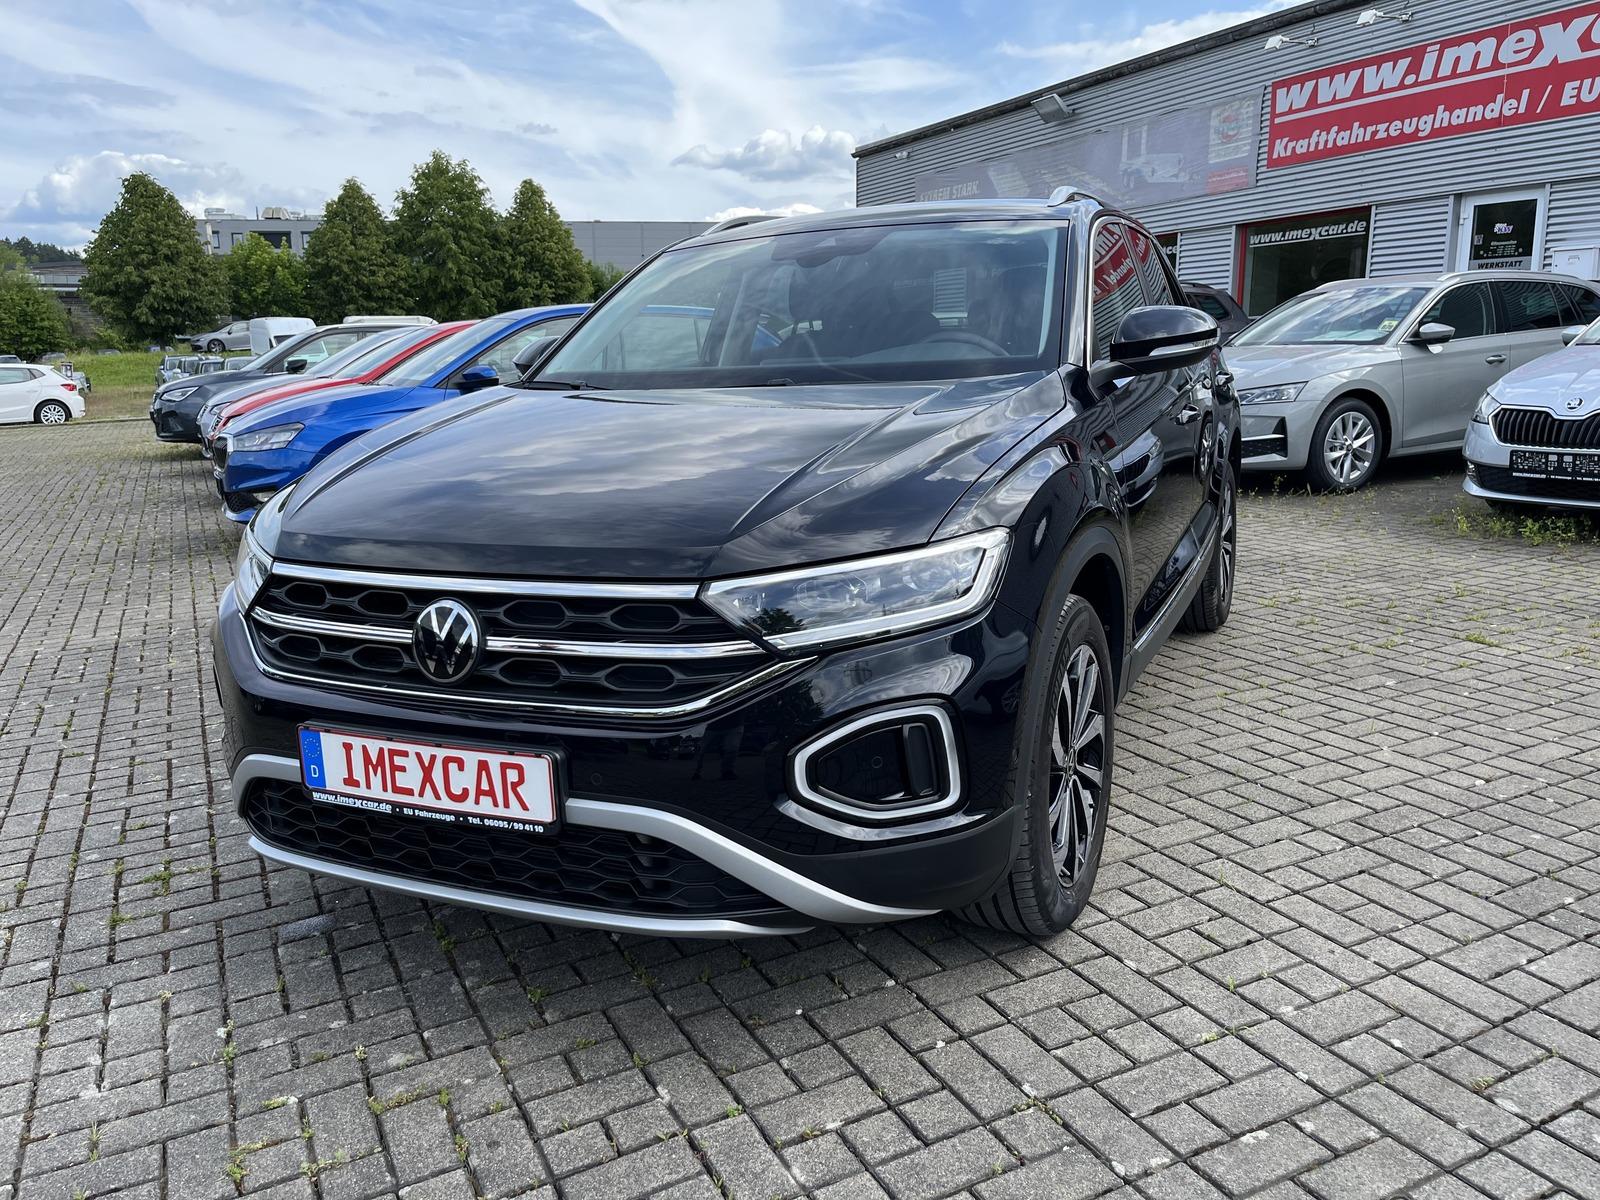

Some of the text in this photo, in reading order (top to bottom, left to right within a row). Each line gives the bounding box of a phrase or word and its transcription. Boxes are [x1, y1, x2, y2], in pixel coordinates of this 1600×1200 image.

[1272, 88, 1530, 159] Kraftfahrzeughandel
[1249, 220, 1367, 245] www.imexcar.de
[1477, 260, 1523, 270] WERKSTATT
[310, 765, 319, 778] D
[342, 742, 530, 811] IMEXCAR
[312, 791, 392, 812] www.imexcar.de
[403, 807, 413, 815] EU
[414, 809, 455, 822] Fahrzeuge
[467, 816, 483, 825] Tel.
